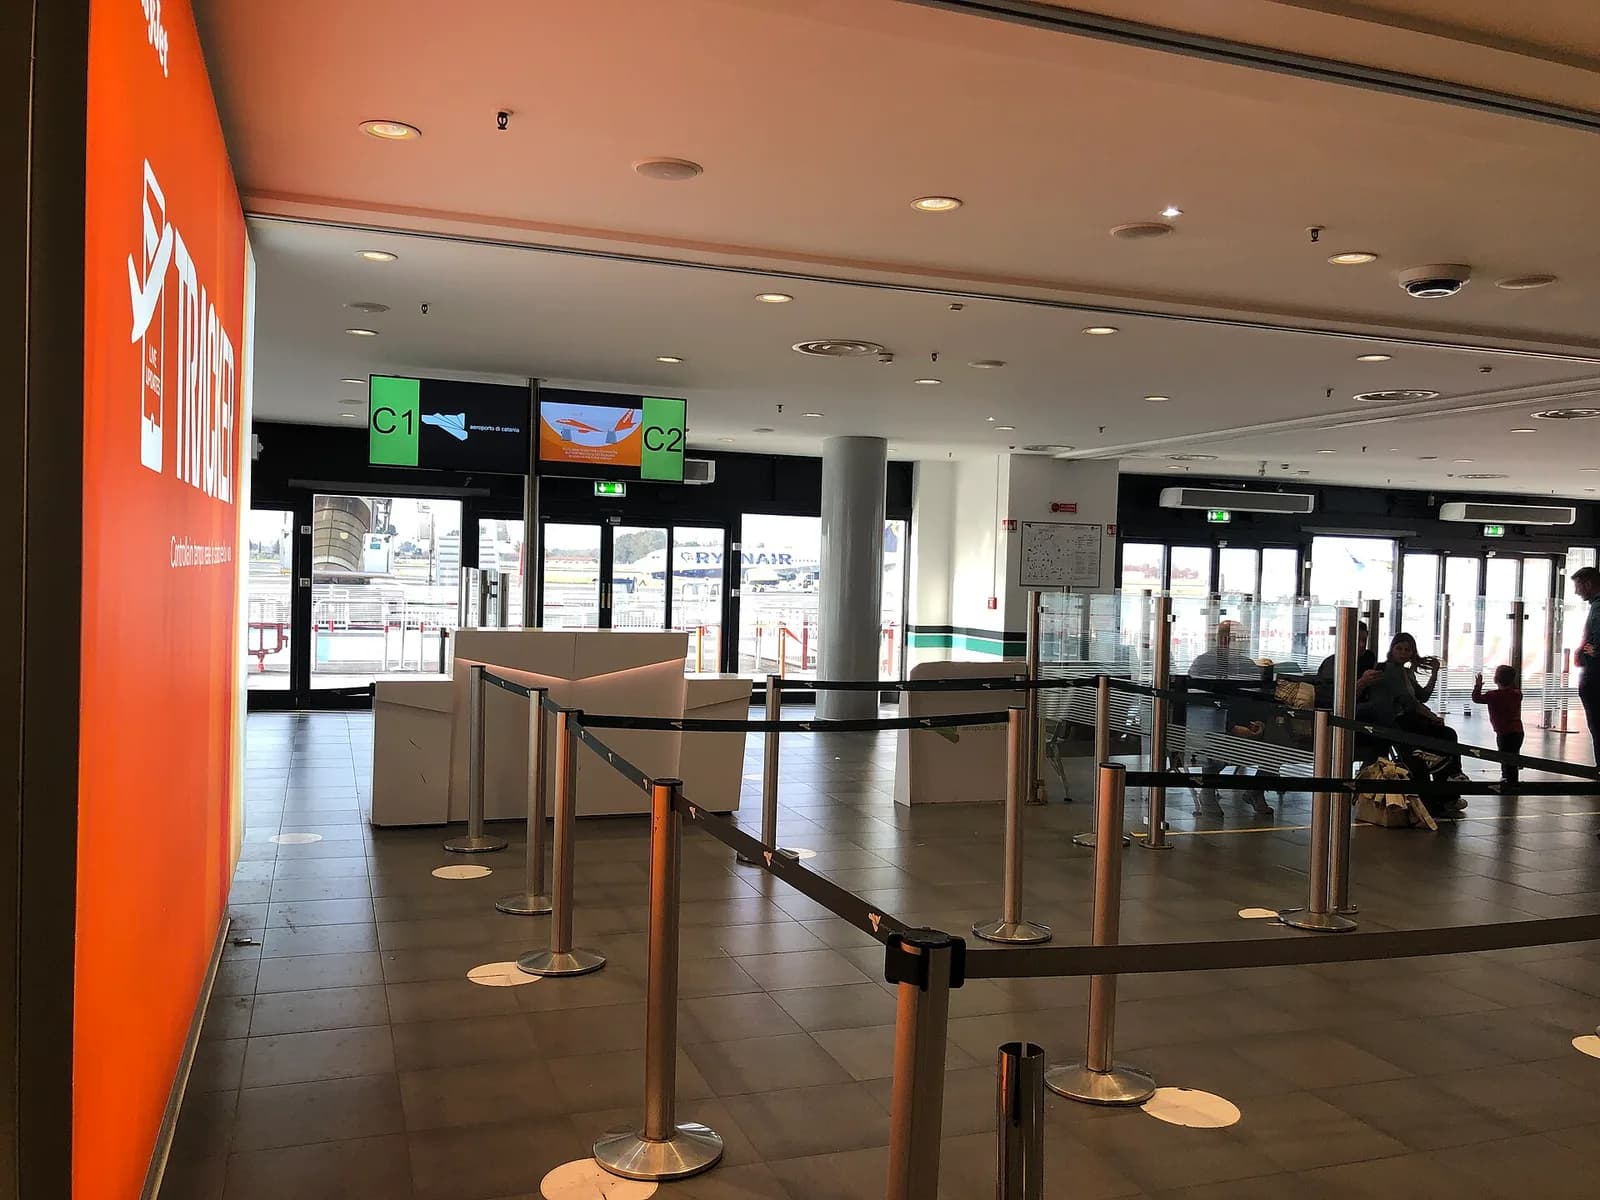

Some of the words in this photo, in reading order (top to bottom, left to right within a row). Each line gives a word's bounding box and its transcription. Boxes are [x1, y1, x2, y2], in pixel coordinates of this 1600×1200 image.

[175, 228, 235, 505] TRACKER
[372, 407, 415, 436] C1
[644, 425, 683, 453] C2
[695, 551, 793, 565] RYNAIR
